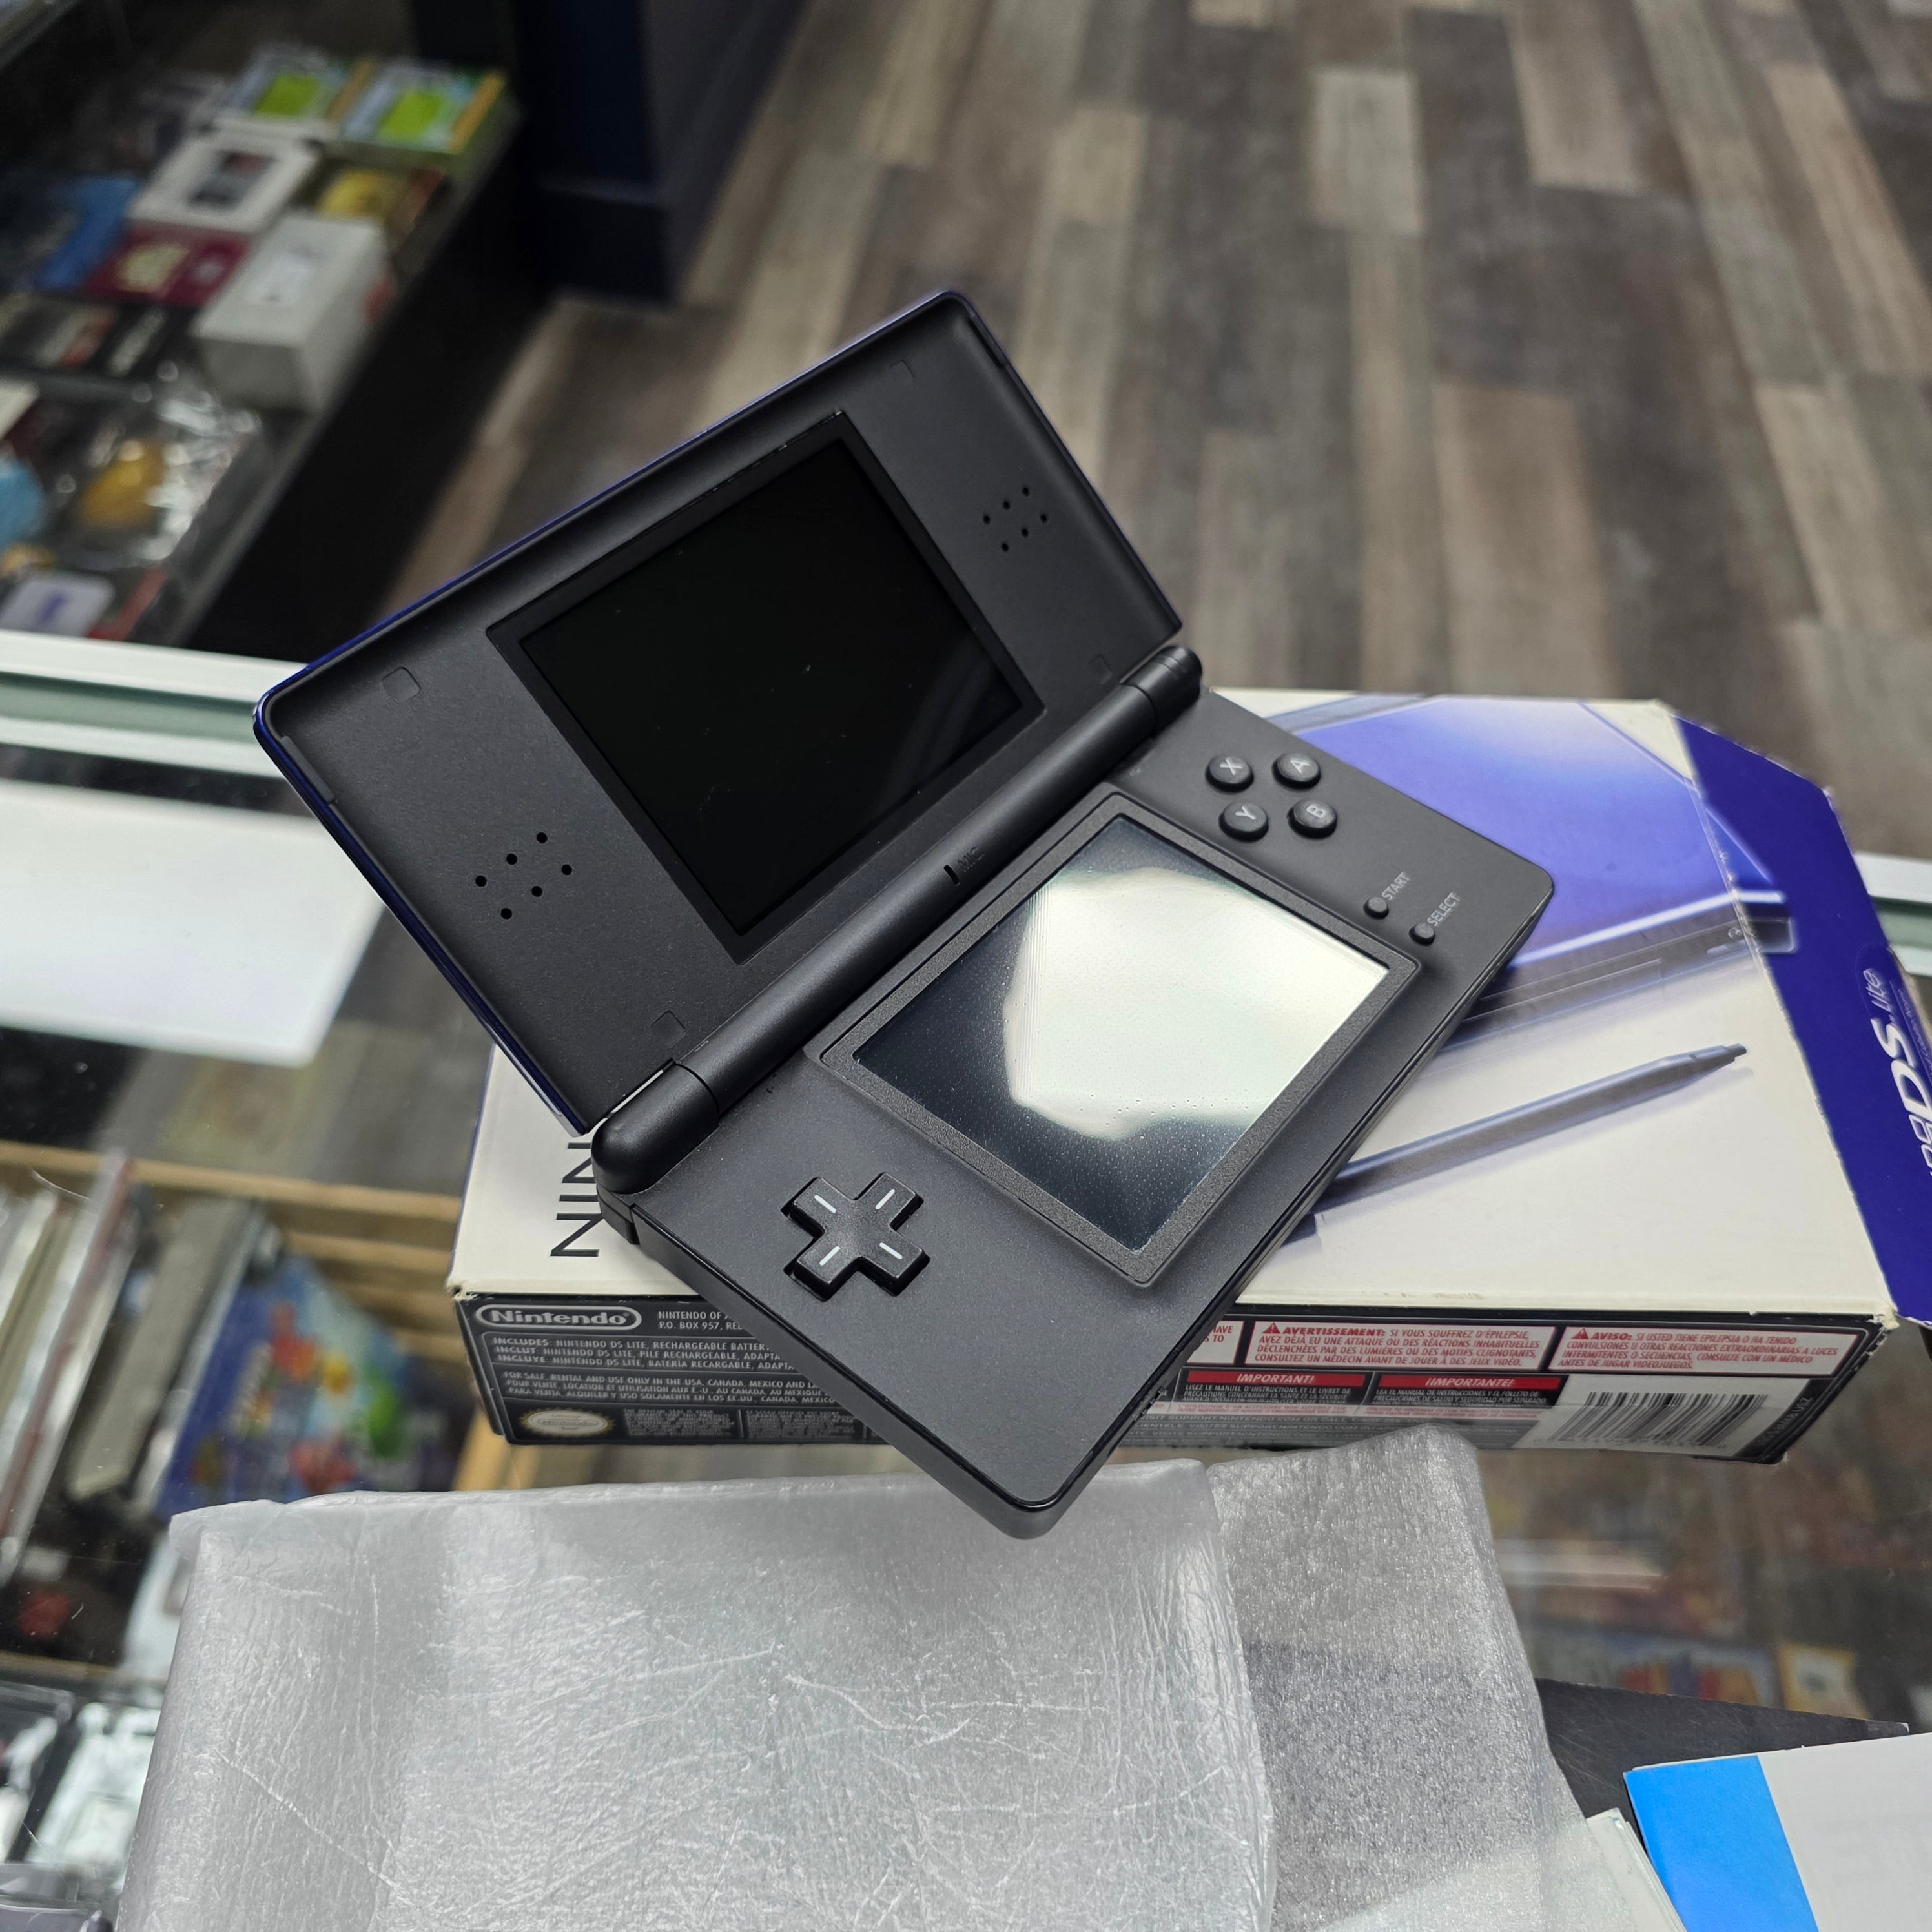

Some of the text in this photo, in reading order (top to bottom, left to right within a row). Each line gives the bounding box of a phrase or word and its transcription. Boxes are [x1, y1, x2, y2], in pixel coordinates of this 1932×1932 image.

[1219, 758, 1243, 775] X
[1290, 758, 1310, 774] A
[1235, 805, 1257, 821] Y
[1305, 804, 1327, 819] B
[1381, 870, 1412, 902] START
[1426, 890, 1462, 927] SELECT
[1863, 968, 1893, 1014] Lite
[491, 1310, 627, 1325] Nintendo
[658, 1311, 706, 1320] NINTENDO
[709, 1311, 722, 1320] OF
[659, 1321, 723, 1330] P.O. BOX 957,
[1213, 1334, 1224, 1342] TO
[1282, 1326, 1386, 1336] AVERTISSEMENT:
[1389, 1328, 1398, 1337] SI
[1401, 1329, 1425, 1337] VOUS
[1428, 1330, 1474, 1339] SOUFFREZ
[1591, 1332, 1633, 1341] AVISO:
[1636, 1333, 1645, 1341] SI
[1646, 1333, 1673, 1342] USTED
[1674, 1333, 1700, 1342] TIENE
[1700, 1334, 1741, 1344] EPILEPSIA
[1752, 1335, 1763, 1344] HA
[1766, 1336, 1797, 1345] TENIDO
[492, 1337, 727, 1350] INCLUDES: NINTENDO DS LITE, RECHARGEABLE
[1259, 1335, 1283, 1344] AVEZ
[1284, 1334, 1306, 1344] DÉJÀ
[1308, 1336, 1321, 1344] EU
[1323, 1337, 1342, 1345] UNE
[1344, 1337, 1384, 1346] ATTAQUE
[1402, 1338, 1420, 1346] DES
[1421, 1337, 1471, 1347] RÉACTIONS
[1472, 1339, 1541, 1348] INHABITUELLES
[1567, 1341, 1629, 1350] CONVULSIONES
[1669, 1343, 1718, 1352] REACCIONES
[1719, 1344, 1800, 1354] EXTRAORDINARIAS
[543, 1348, 594, 1357] NINTENDO
[613, 1350, 636, 1358] LITE,
[663, 1351, 740, 1361] RECHARGEABLE,
[1257, 1343, 1317, 1353] DÉCLENCHÉES
[1359, 1345, 1403, 1355] LUMIÈRES
[1476, 1349, 1536, 1358] CLIGNOTANTS,
[1563, 1350, 1628, 1359] INTERMITENTES
[1639, 1352, 1692, 1361] SECUENCIAS,
[1742, 1354, 1761, 1362] CON
[498, 1355, 548, 1363] INCLUYE:
[553, 1357, 602, 1366] NINTENDO
[622, 1359, 644, 1368] LITE,
[691, 1361, 754, 1370] RECARGABLE,
[1255, 1353, 1305, 1362] CONSULTEZ
[1364, 1355, 1393, 1364] AVANT
[1601, 1360, 1631, 1368] JUGAR
[1632, 1361, 1694, 1369] VIDEOJUEGOS.
[1236, 1373, 1315, 1384] IMPORTANT!
[1424, 1377, 1515, 1387] ¡IMPORTANTE!
